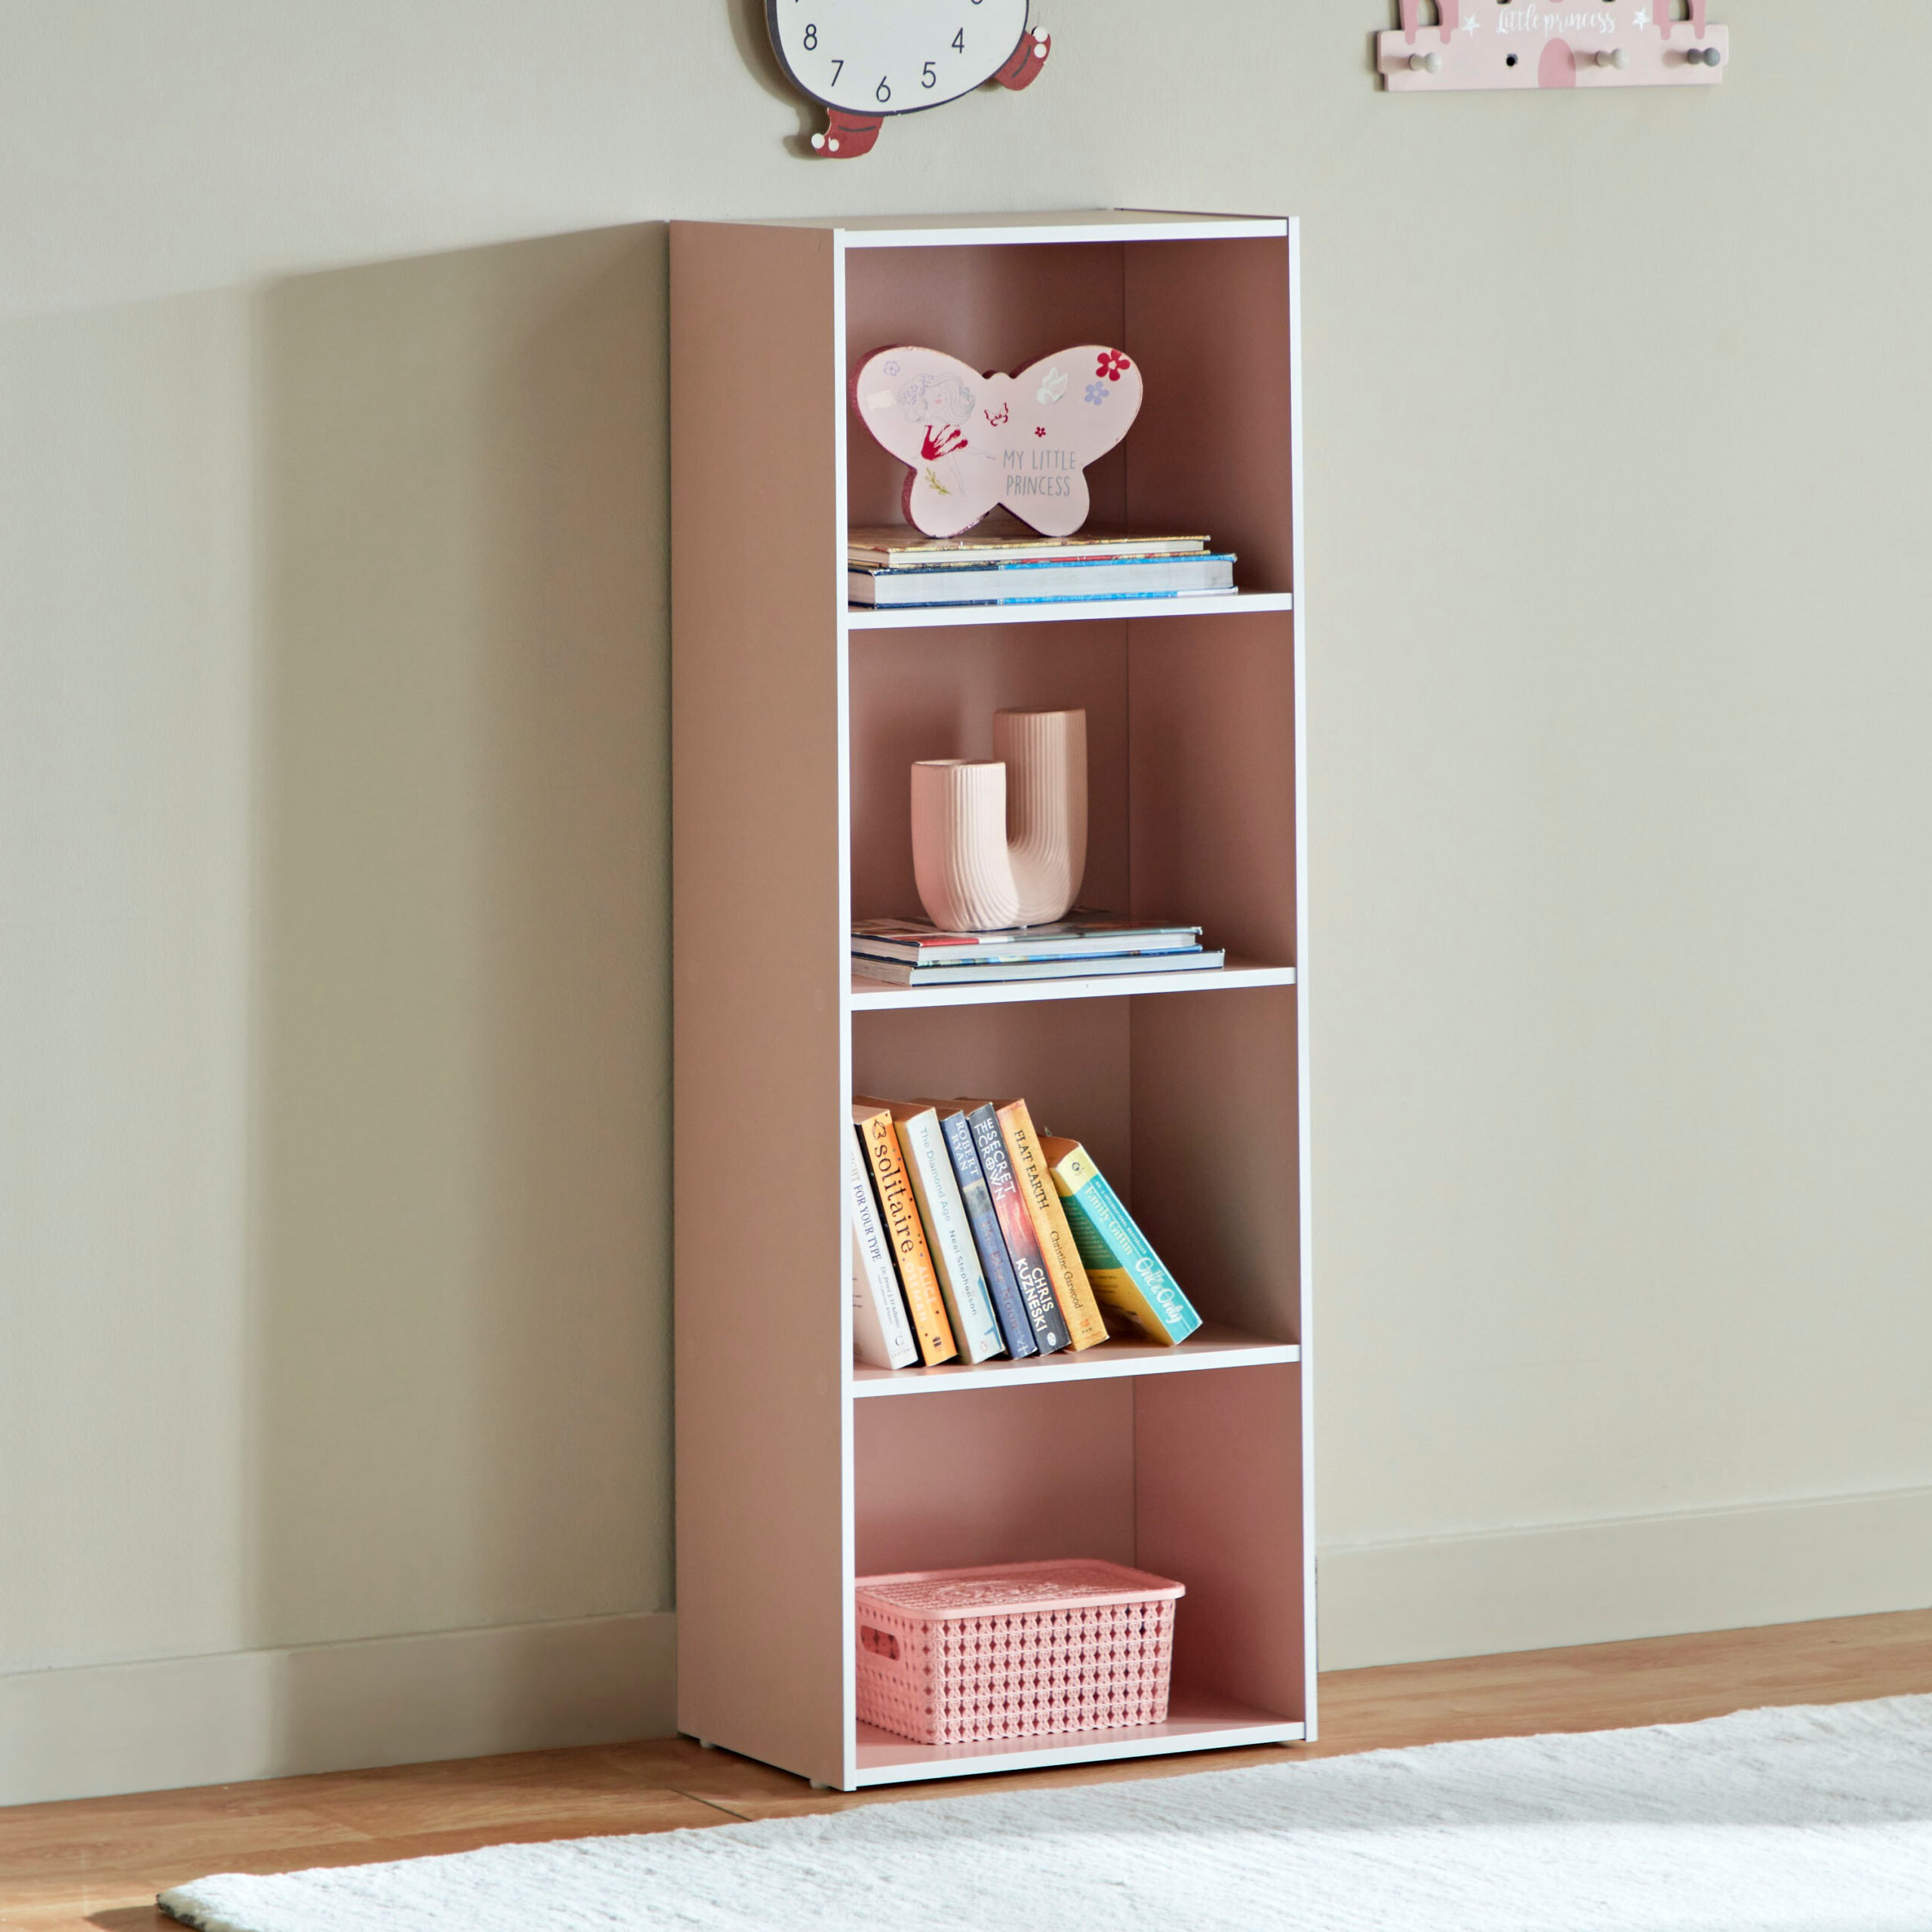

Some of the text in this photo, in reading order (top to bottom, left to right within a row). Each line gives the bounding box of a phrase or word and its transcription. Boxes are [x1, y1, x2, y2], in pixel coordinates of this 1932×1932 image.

[803, 23, 817, 51] 8
[952, 27, 964, 54] 4
[832, 60, 844, 87] 7
[875, 75, 891, 103] 6
[921, 62, 937, 88] 5
[1003, 449, 1076, 471] MY LITTLE
[1005, 474, 1071, 497] PRINCESS
[973, 1116, 995, 1136] THE
[950, 1133, 968, 1172] RYAN
[954, 1119, 980, 1177] ROBERT
[977, 1132, 1005, 1202] CROWN
[986, 1128, 1017, 1198] SECRET
[1013, 1128, 1050, 1211] FLAT EARTH
[852, 1183, 867, 1206] FOR
[919, 1126, 952, 1223] The Diamond Age
[858, 1205, 875, 1235] YOUR
[873, 1142, 915, 1255] solitaire
[1084, 1184, 1112, 1223] Emily
[1106, 1217, 1135, 1256] Giffin
[866, 1235, 882, 1262] TYPE
[1048, 1229, 1084, 1310] Christine Garwood
[903, 1260, 928, 1324] OSEMAN
[916, 1263, 937, 1306] ALICE
[948, 1229, 978, 1317] Neal Stephenson
[1014, 1256, 1048, 1333] KUZNESKI
[1029, 1264, 1055, 1313] CHRIS
